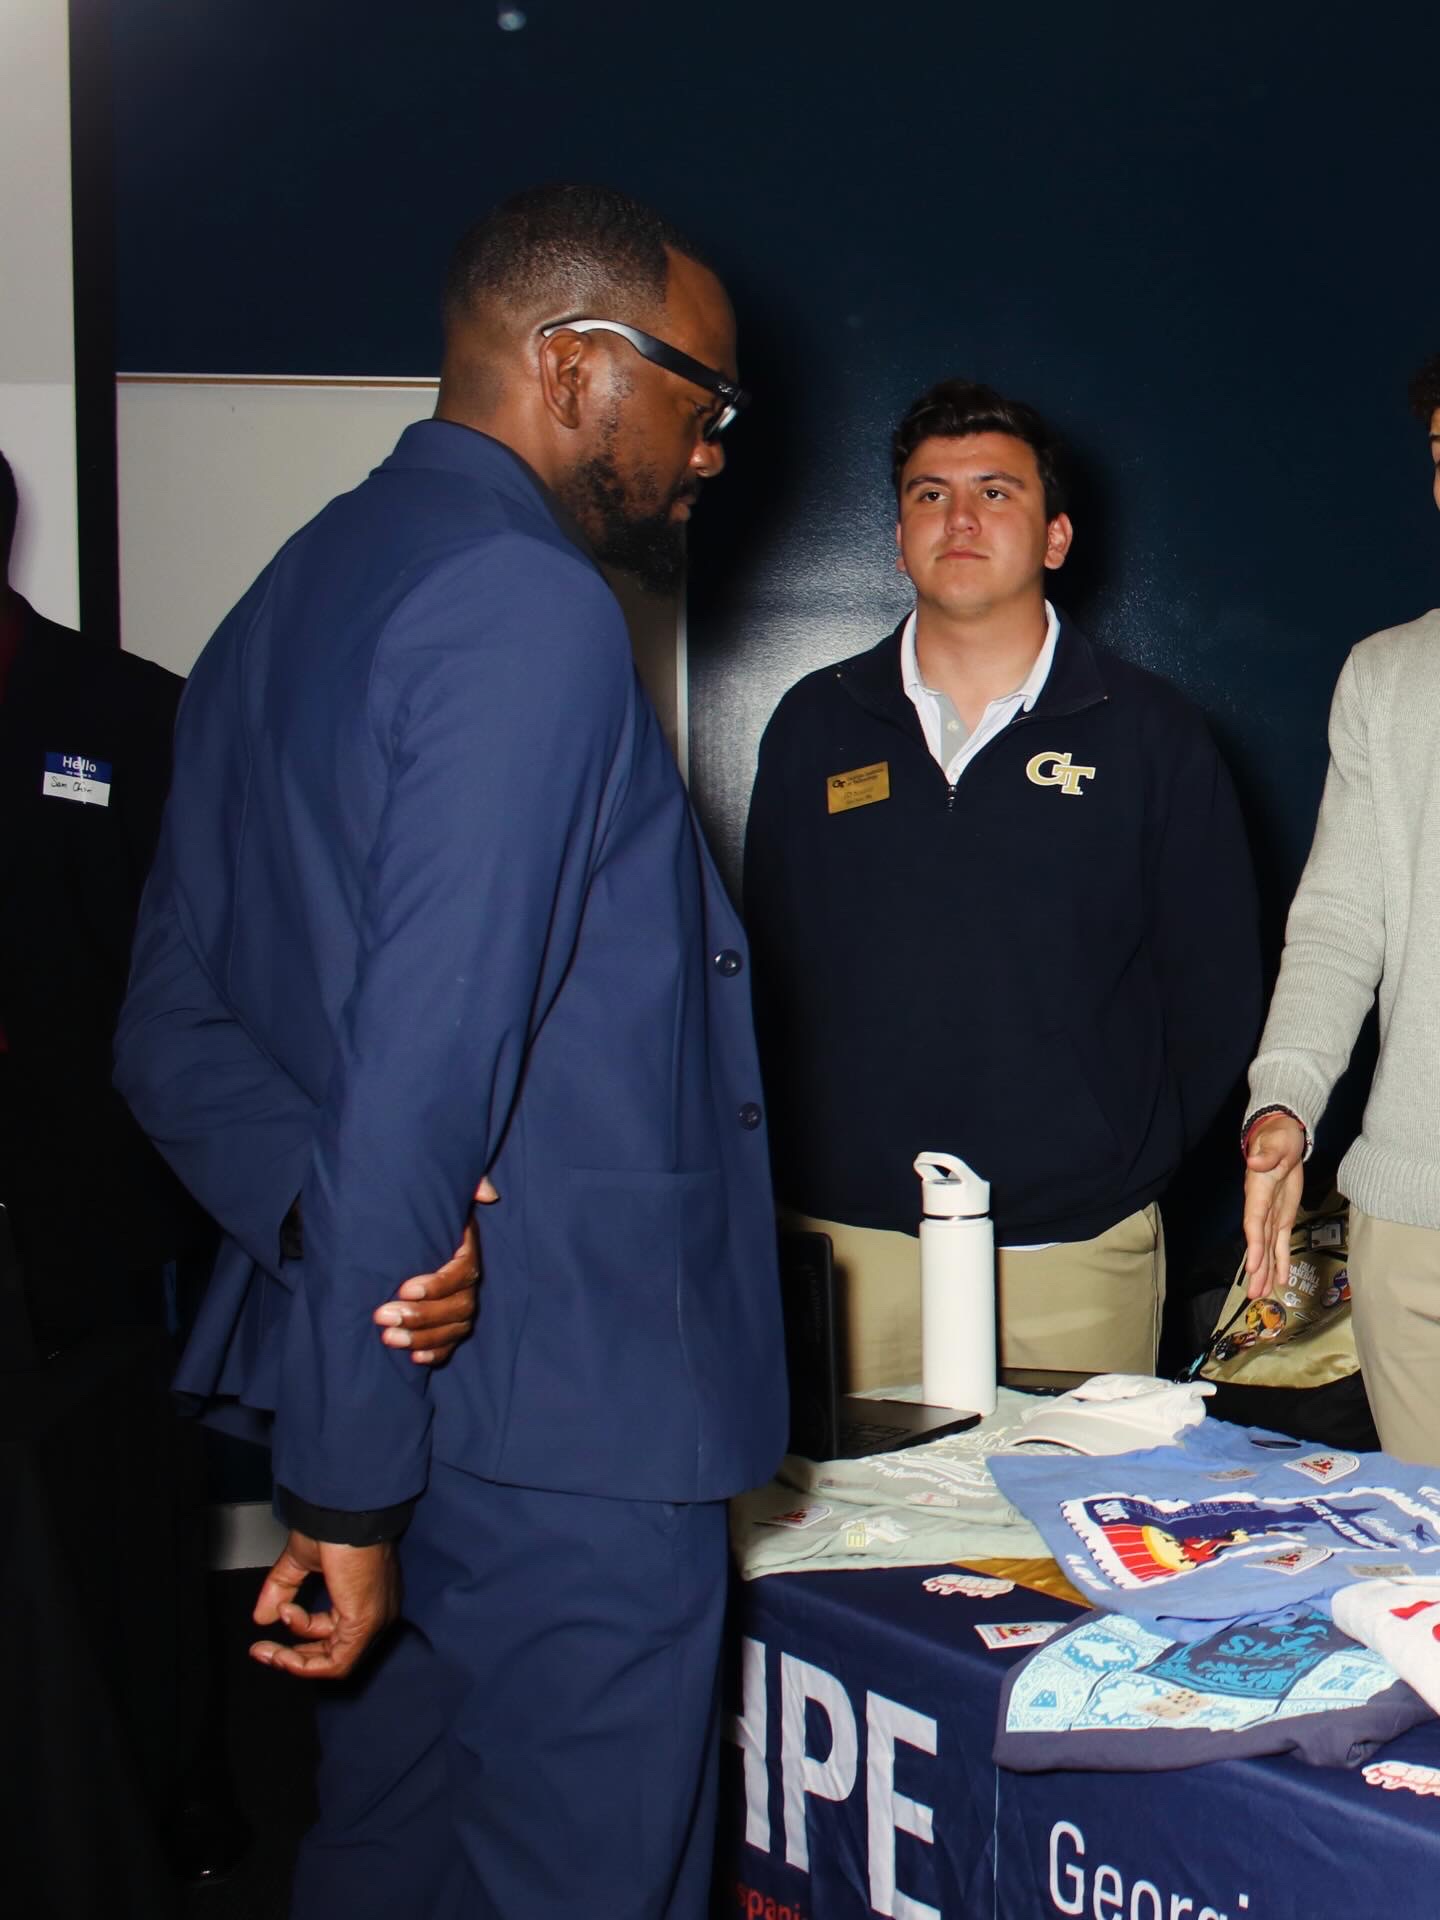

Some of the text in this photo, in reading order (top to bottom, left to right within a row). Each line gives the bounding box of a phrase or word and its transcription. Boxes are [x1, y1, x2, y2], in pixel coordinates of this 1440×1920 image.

[62, 756, 97, 773] Hello
[1026, 751, 1096, 795] GT
[1050, 1820, 1249, 1920] Geor
